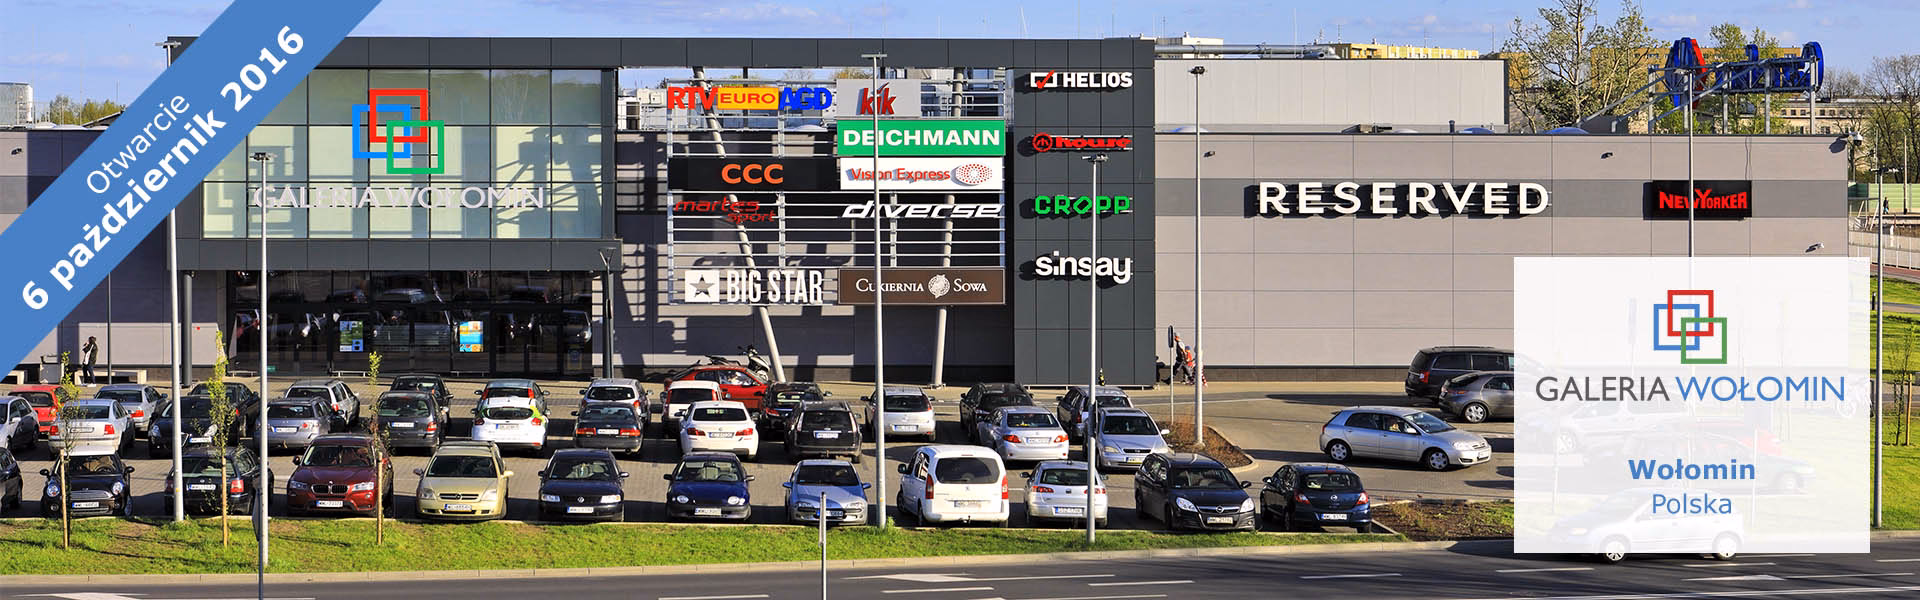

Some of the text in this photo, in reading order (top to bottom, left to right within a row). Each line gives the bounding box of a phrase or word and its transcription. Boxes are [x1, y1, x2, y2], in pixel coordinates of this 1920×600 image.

[1063, 71, 1133, 88] HELIOS
[667, 86, 833, 111] RTV EURO AGD
[860, 81, 897, 115] kik
[843, 129, 1000, 146] DEICHMANN
[1055, 136, 1132, 149] house
[721, 163, 784, 184] CCC
[851, 168, 951, 183] Vision Express
[253, 186, 544, 209] GALERIA WOŁOMIN
[674, 196, 760, 212] martes
[1035, 195, 1131, 215] CROPP
[1259, 181, 1549, 215] RESERVED
[1659, 188, 1748, 209] NEW YORKER
[727, 210, 776, 224] sport
[1035, 250, 1131, 284] sinsay
[727, 270, 823, 304] BIG STAR
